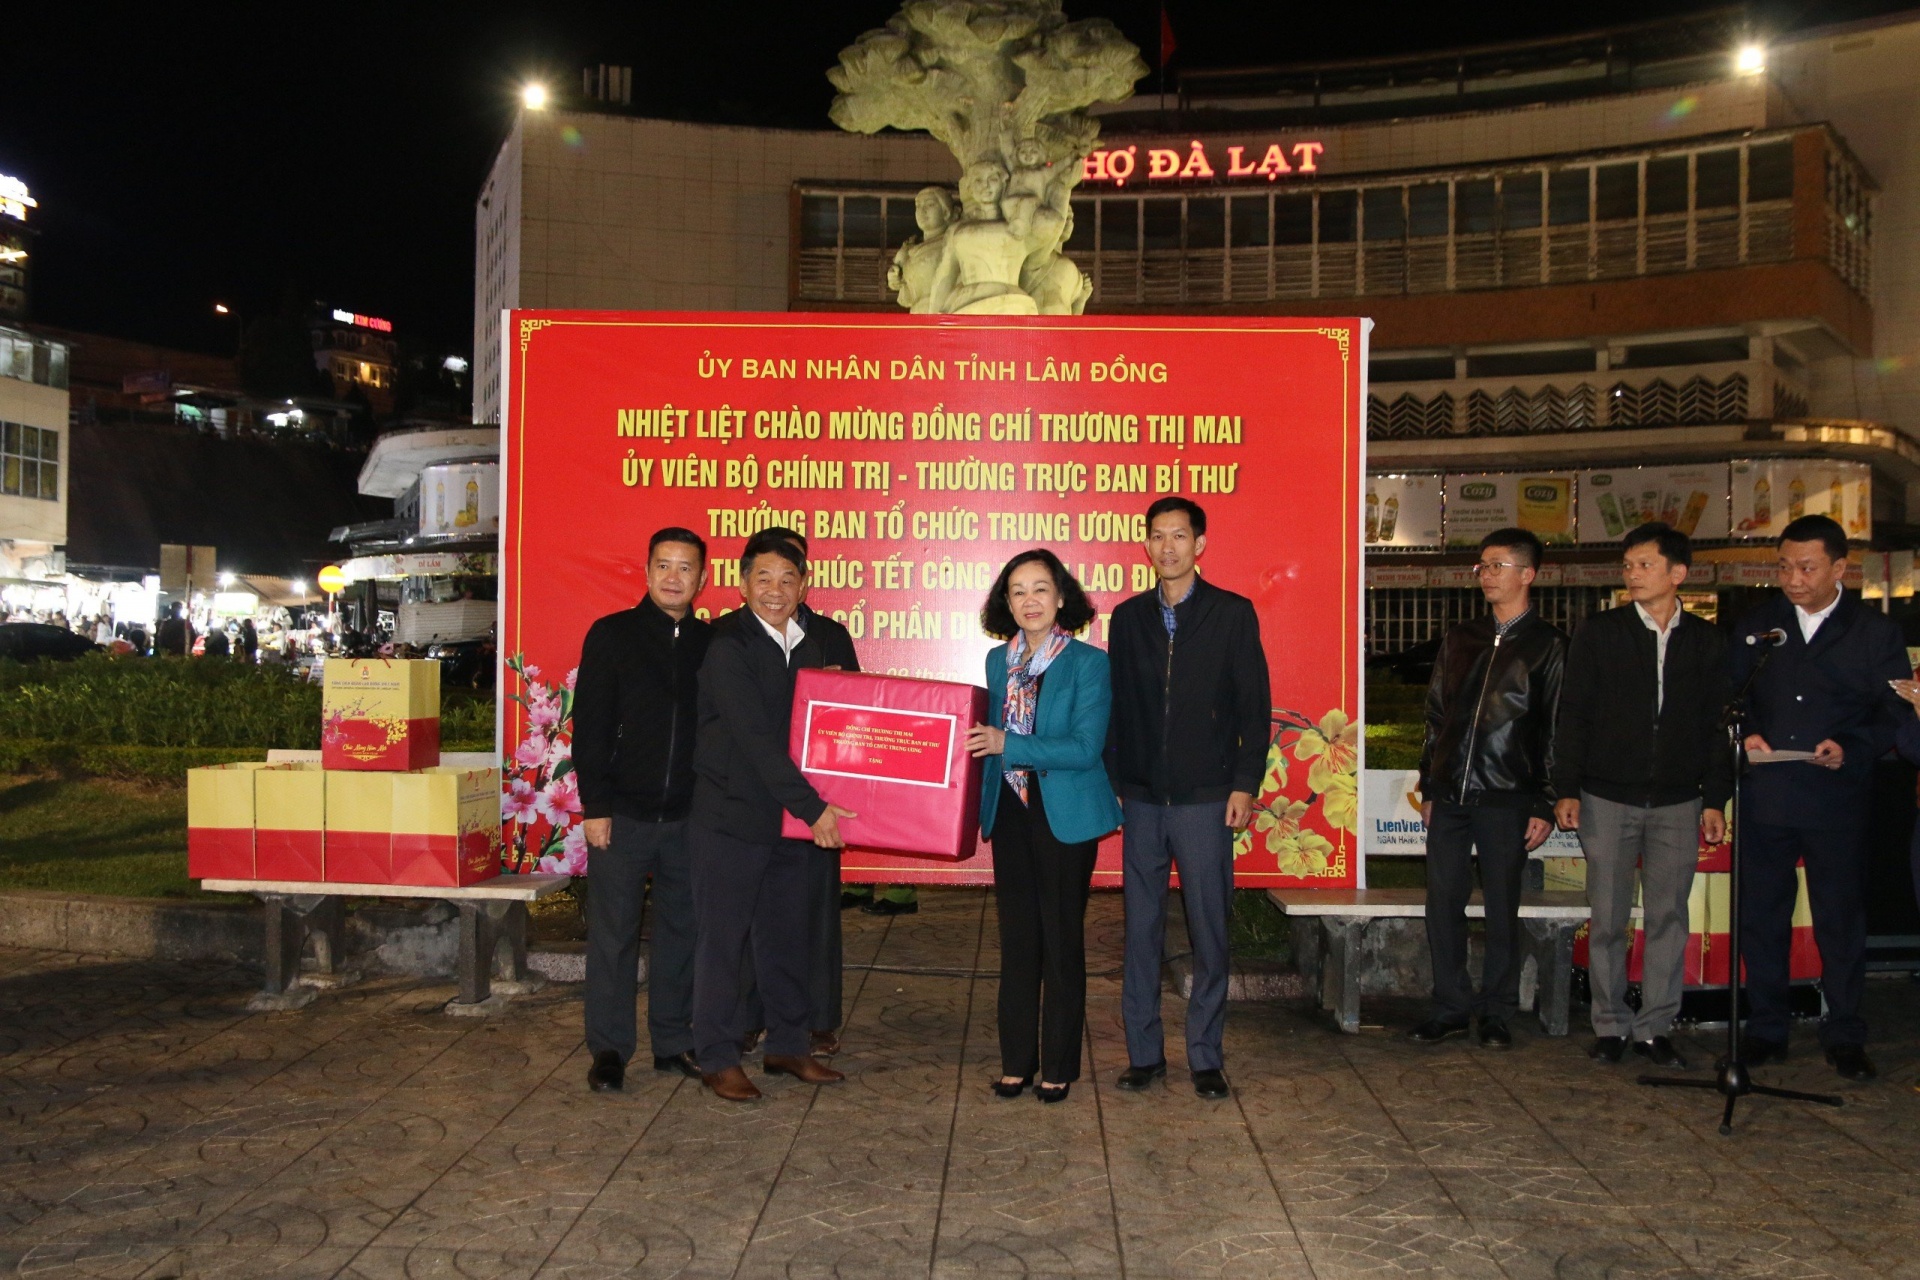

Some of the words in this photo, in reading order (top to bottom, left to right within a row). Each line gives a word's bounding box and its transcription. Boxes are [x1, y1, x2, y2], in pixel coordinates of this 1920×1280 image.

[1082, 145, 1136, 187] HỢ
[1148, 140, 1214, 178] ĐÀ
[1227, 142, 1323, 181] LẠT
[698, 350, 732, 378] ỦY
[742, 359, 796, 379] BAN
[806, 354, 880, 380] NHÂN
[890, 355, 945, 380] DÂN
[954, 352, 1015, 381] TỈNH
[1026, 356, 1080, 382] LÂM
[1090, 354, 1167, 383] ĐỒNG
[617, 403, 689, 443] NHIỆT
[697, 404, 746, 444] LIỆT
[754, 404, 821, 440] CHÀO
[829, 406, 904, 440] MỪNG
[912, 402, 981, 441] ĐỒNG
[989, 407, 1032, 442] CHÍ
[1039, 411, 1139, 443] TRƯƠNG
[1146, 415, 1185, 450] THỊ
[1193, 415, 1241, 444] MAI
[622, 448, 654, 486] ỦY
[661, 453, 717, 487] VIÊN
[725, 454, 759, 494] BỘ
[767, 454, 843, 489] CHÍNH
[851, 461, 890, 495] TRỊ
[916, 455, 1015, 491] THƯỜNG
[1023, 460, 1087, 498] TRỰC
[1095, 463, 1147, 493] BAN
[1155, 459, 1180, 493] BÍ
[1188, 462, 1238, 493] THƯ
[1463, 486, 1494, 498] Cozy
[1527, 486, 1555, 499] Cozy
[707, 499, 806, 538] TRƯỞNG
[814, 510, 866, 539] BAN
[874, 499, 905, 539] TỔ
[912, 506, 979, 541] CHỨC
[987, 512, 1070, 542] TRUNG
[1078, 510, 1147, 542] ƯƠNG
[871, 551, 914, 589] TẾT
[922, 555, 991, 590] CÔNG
[1078, 564, 1124, 592] LAO
[873, 601, 942, 640] PHẦN
